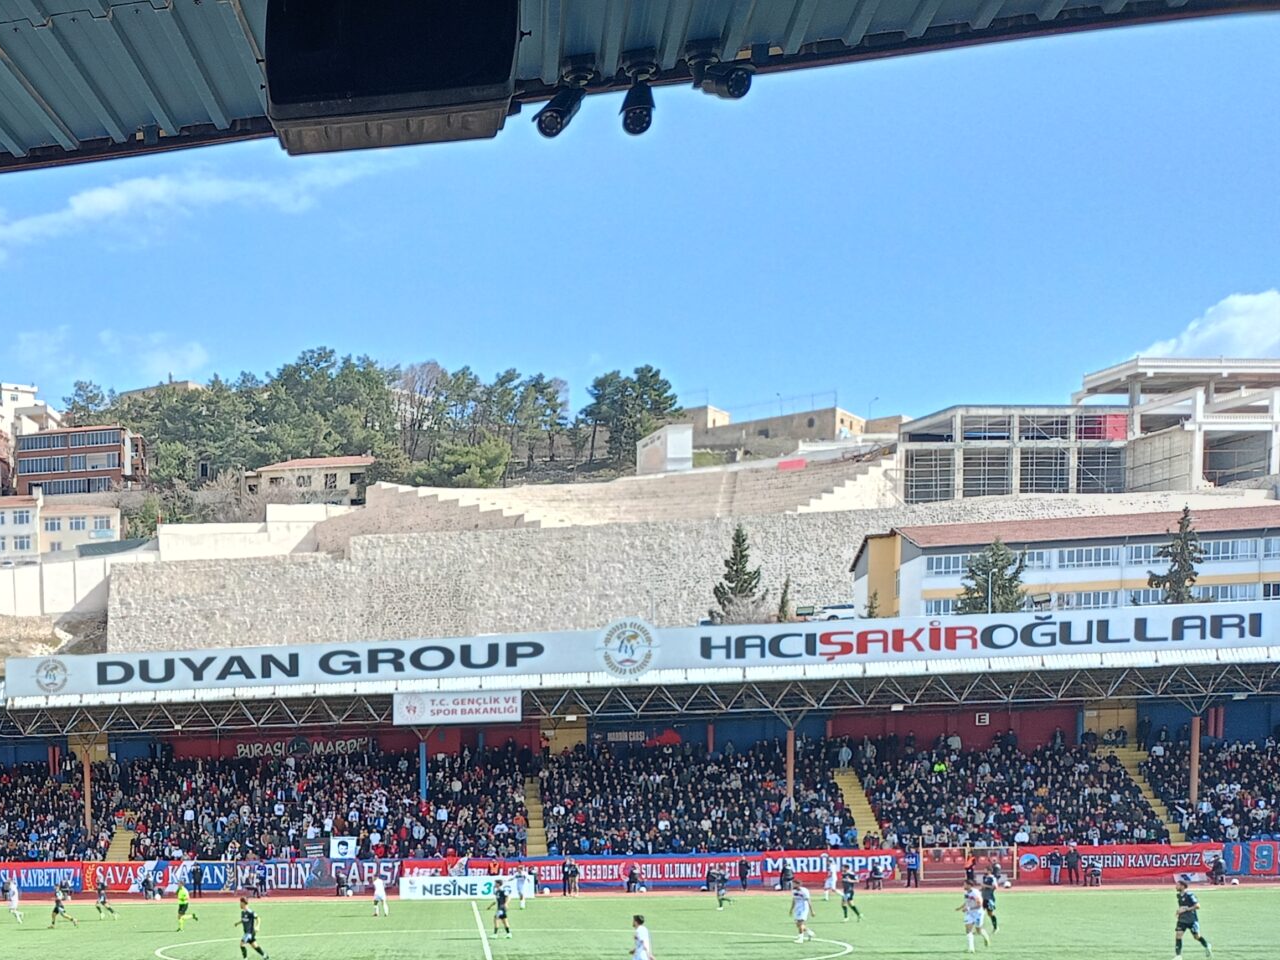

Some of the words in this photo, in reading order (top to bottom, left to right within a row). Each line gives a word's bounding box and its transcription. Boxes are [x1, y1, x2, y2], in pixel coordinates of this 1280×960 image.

[96, 652, 300, 686] DUYAN
[318, 641, 546, 676] GROUP
[504, 696, 518, 704] VE
[430, 708, 458, 717] SPOR
[236, 741, 286, 759] BURASI
[168, 864, 226, 884] KAAN
